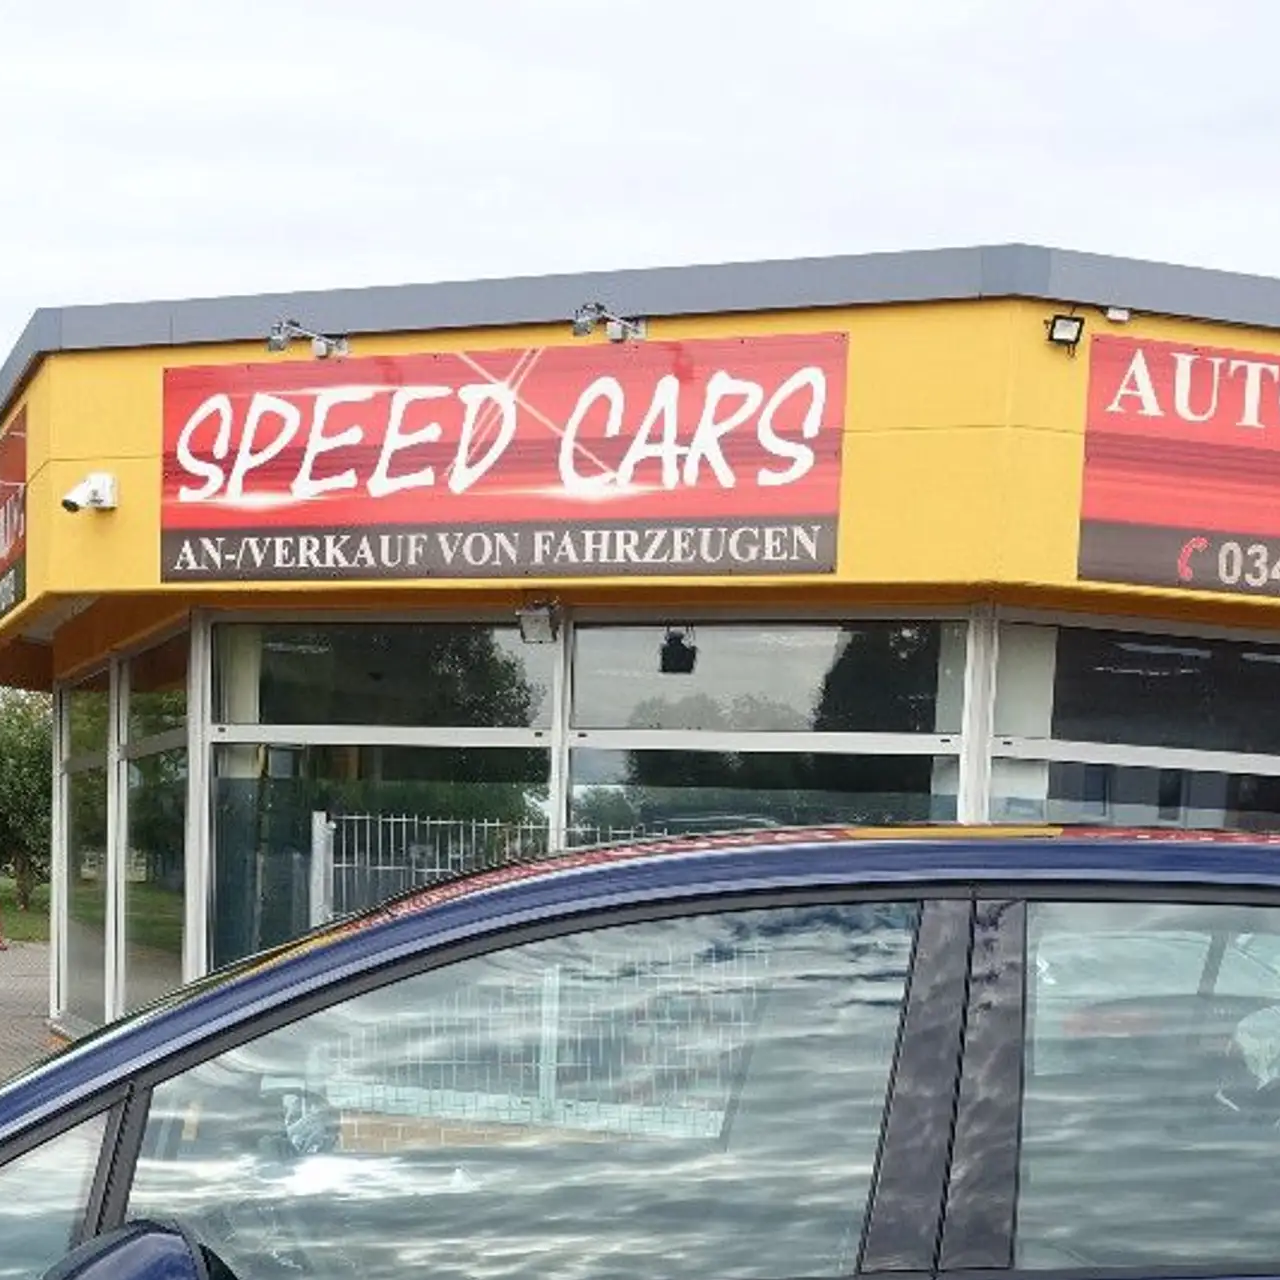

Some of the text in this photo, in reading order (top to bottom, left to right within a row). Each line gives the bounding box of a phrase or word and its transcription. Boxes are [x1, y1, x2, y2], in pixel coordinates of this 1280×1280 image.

[176, 366, 827, 502] SPEED CARS
[438, 532, 519, 565] VON
[532, 525, 822, 565] FAHRZEUGEN
